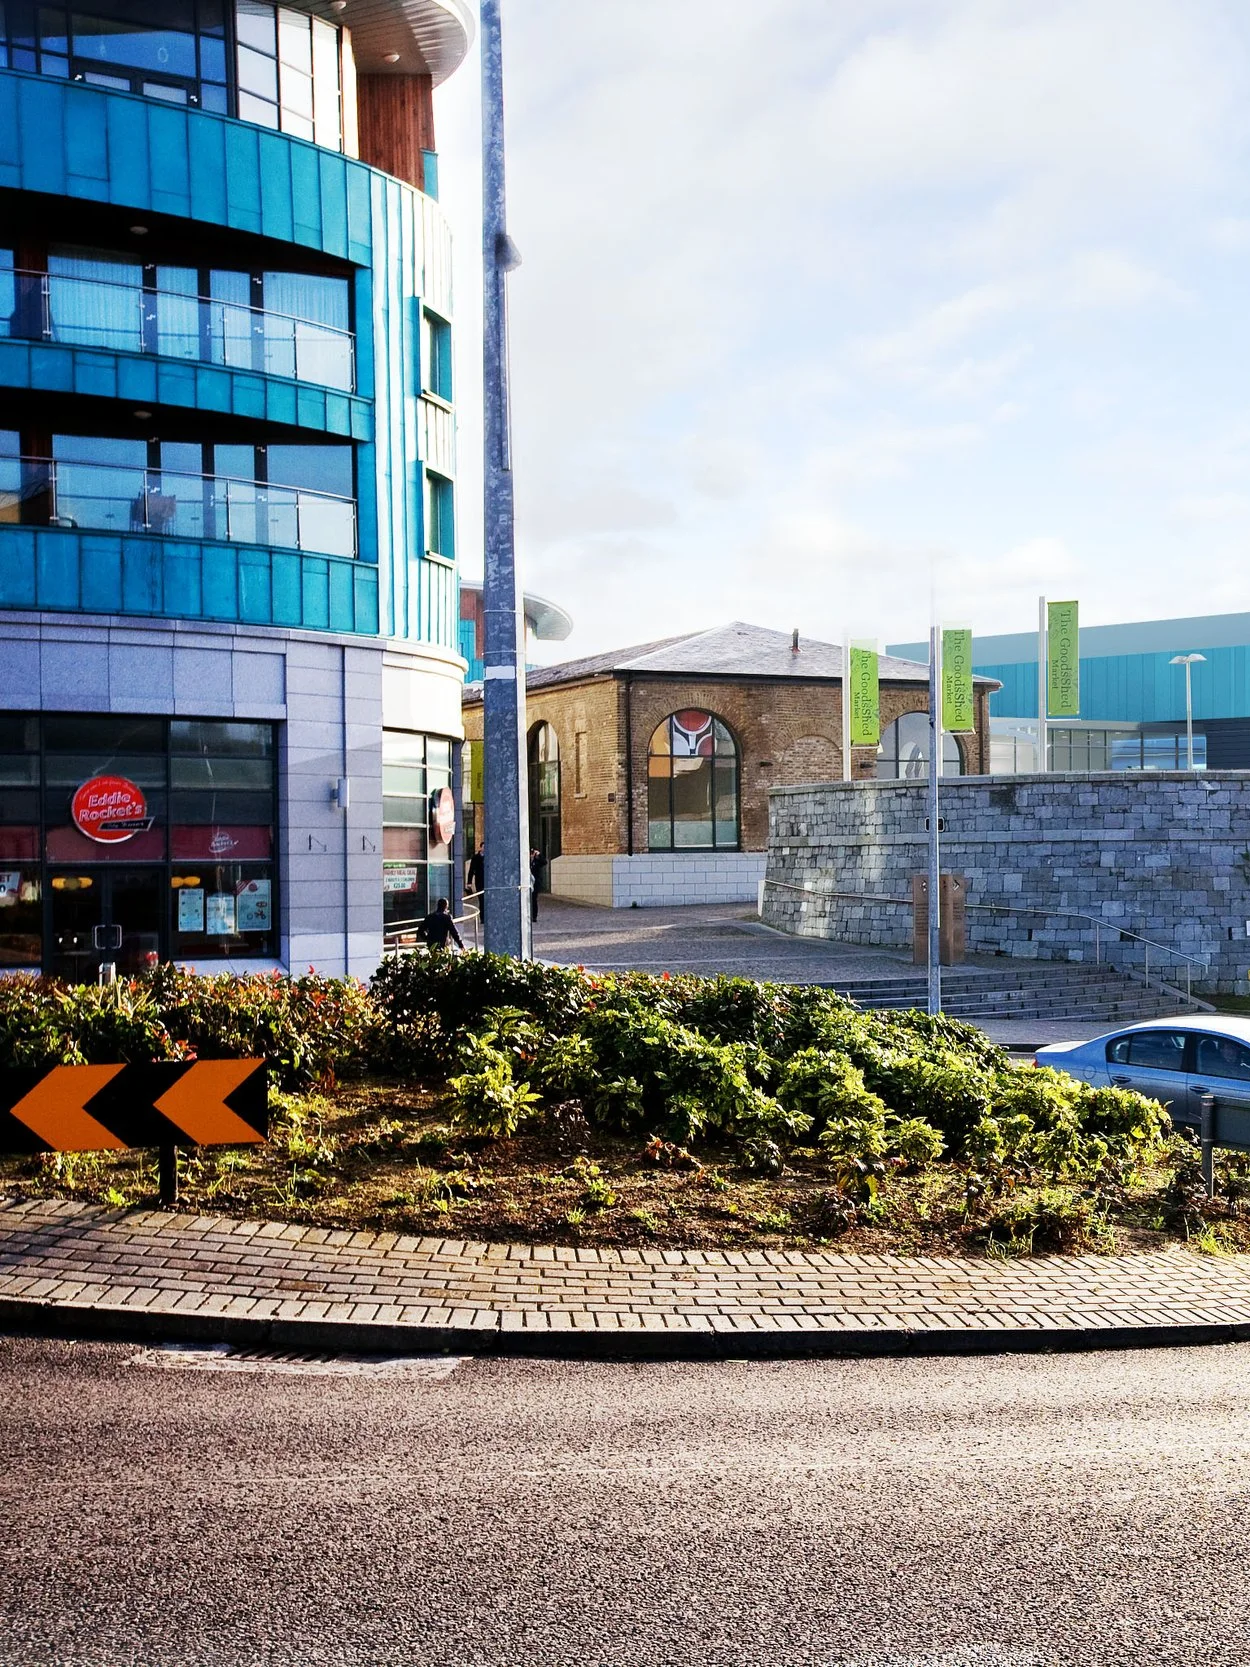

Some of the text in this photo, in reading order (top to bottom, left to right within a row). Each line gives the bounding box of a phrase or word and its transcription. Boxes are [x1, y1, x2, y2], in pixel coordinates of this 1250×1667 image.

[861, 649, 872, 736] The GoodsShed
[954, 630, 965, 722] The GoodsShed
[1060, 610, 1072, 708] The GoodsShed
[78, 801, 143, 822] Rocket's
[88, 791, 131, 808] Eddie
